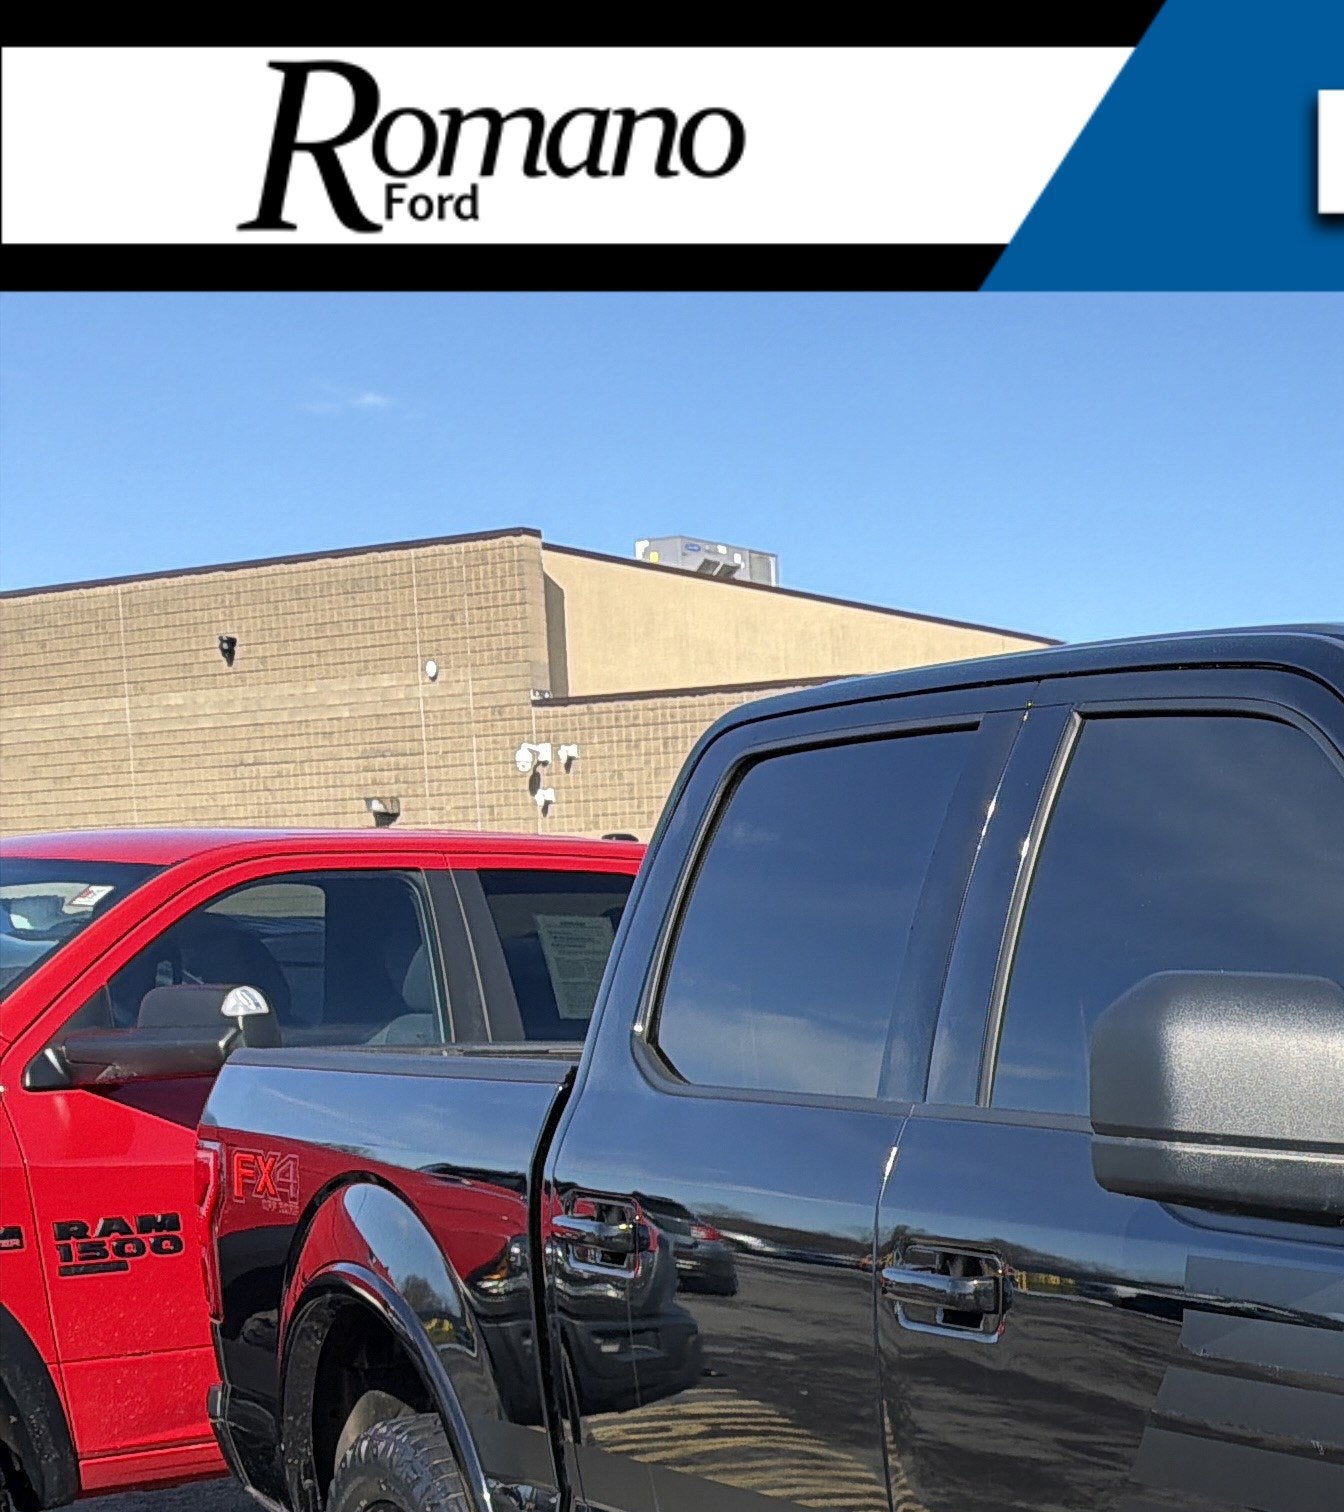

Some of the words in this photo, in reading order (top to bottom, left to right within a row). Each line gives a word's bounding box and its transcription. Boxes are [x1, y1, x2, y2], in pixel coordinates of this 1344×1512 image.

[231, 1148, 300, 1205] FX4
[53, 1212, 182, 1241] RAM
[56, 1235, 185, 1263] 1500
